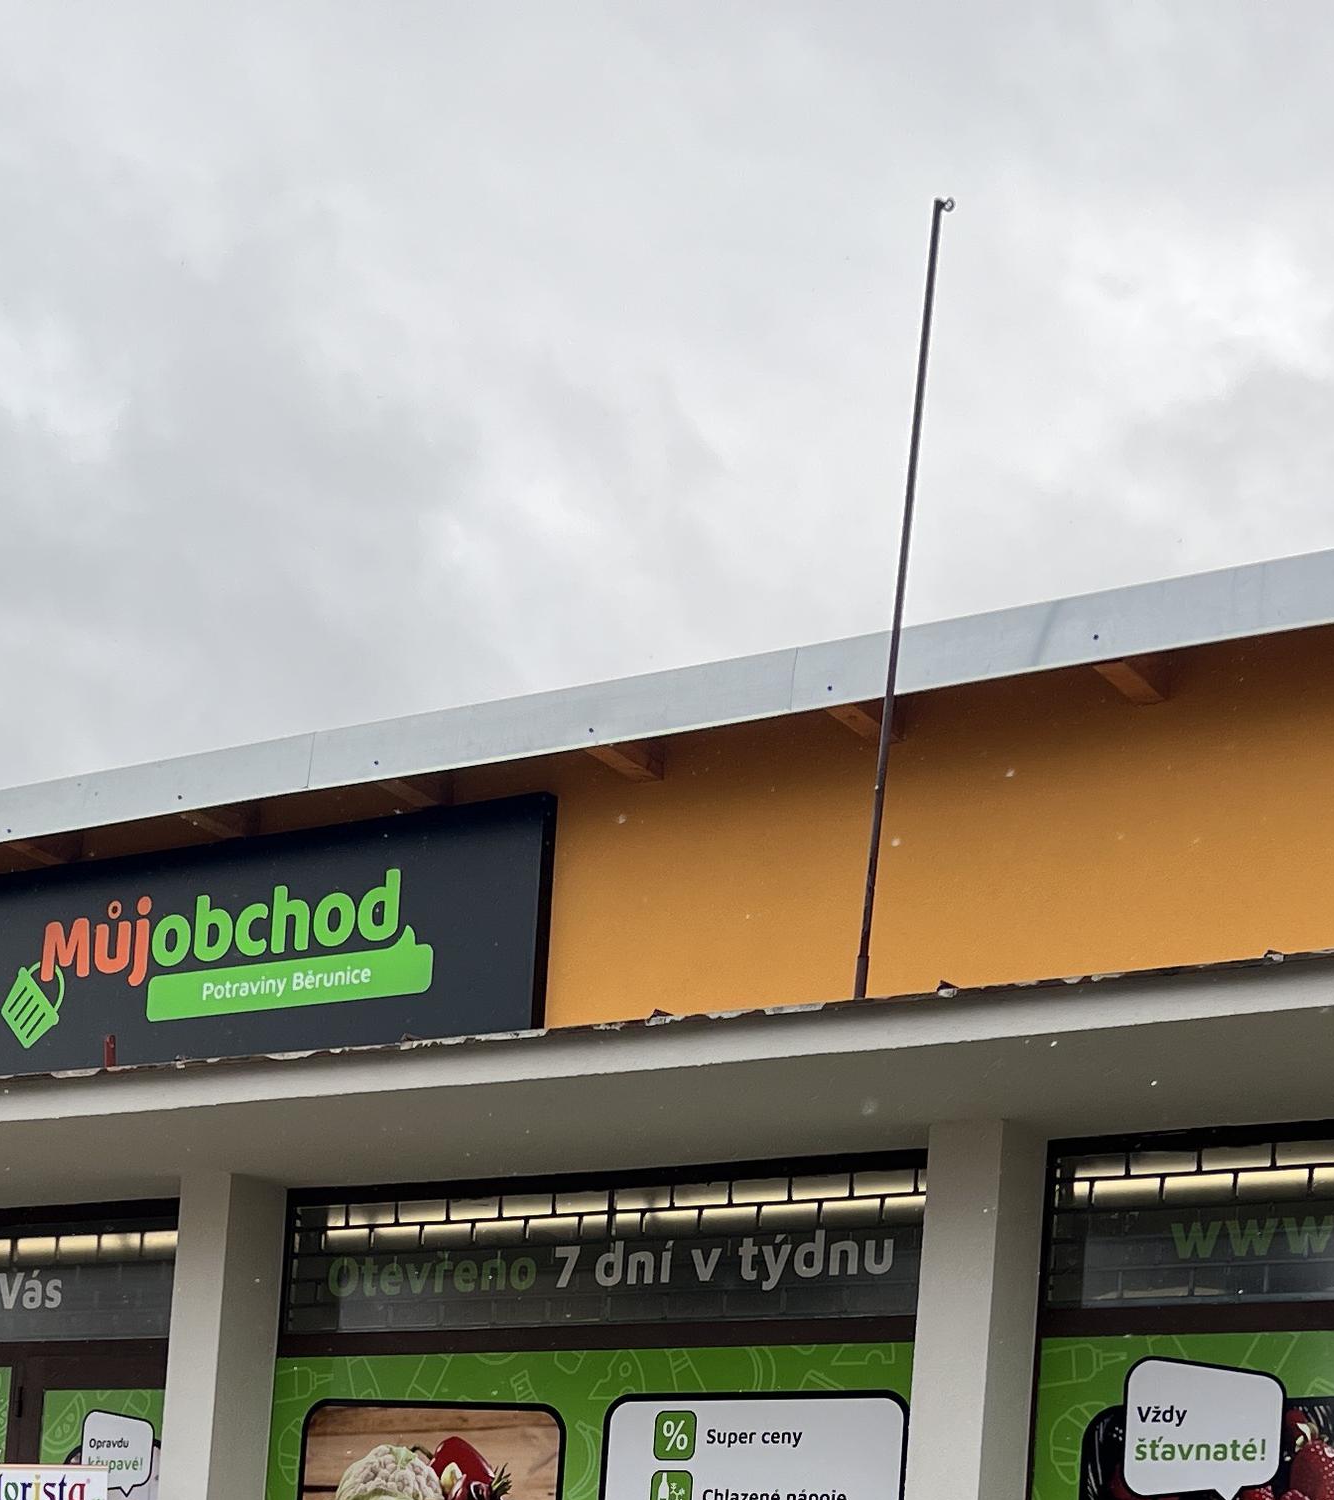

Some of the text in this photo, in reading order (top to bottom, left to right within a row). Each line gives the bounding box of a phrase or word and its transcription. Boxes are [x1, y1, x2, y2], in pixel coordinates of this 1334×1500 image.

[202, 966, 372, 1001] Potraviny Běrunice
[327, 1228, 894, 1297] Otevřeno 7 dní v týdnu
[1136, 1404, 1188, 1428] Vždy
[89, 1438, 130, 1450] Opravdu
[706, 1429, 803, 1448] Super ceny
[1134, 1436, 1267, 1462] šťavnaté!
